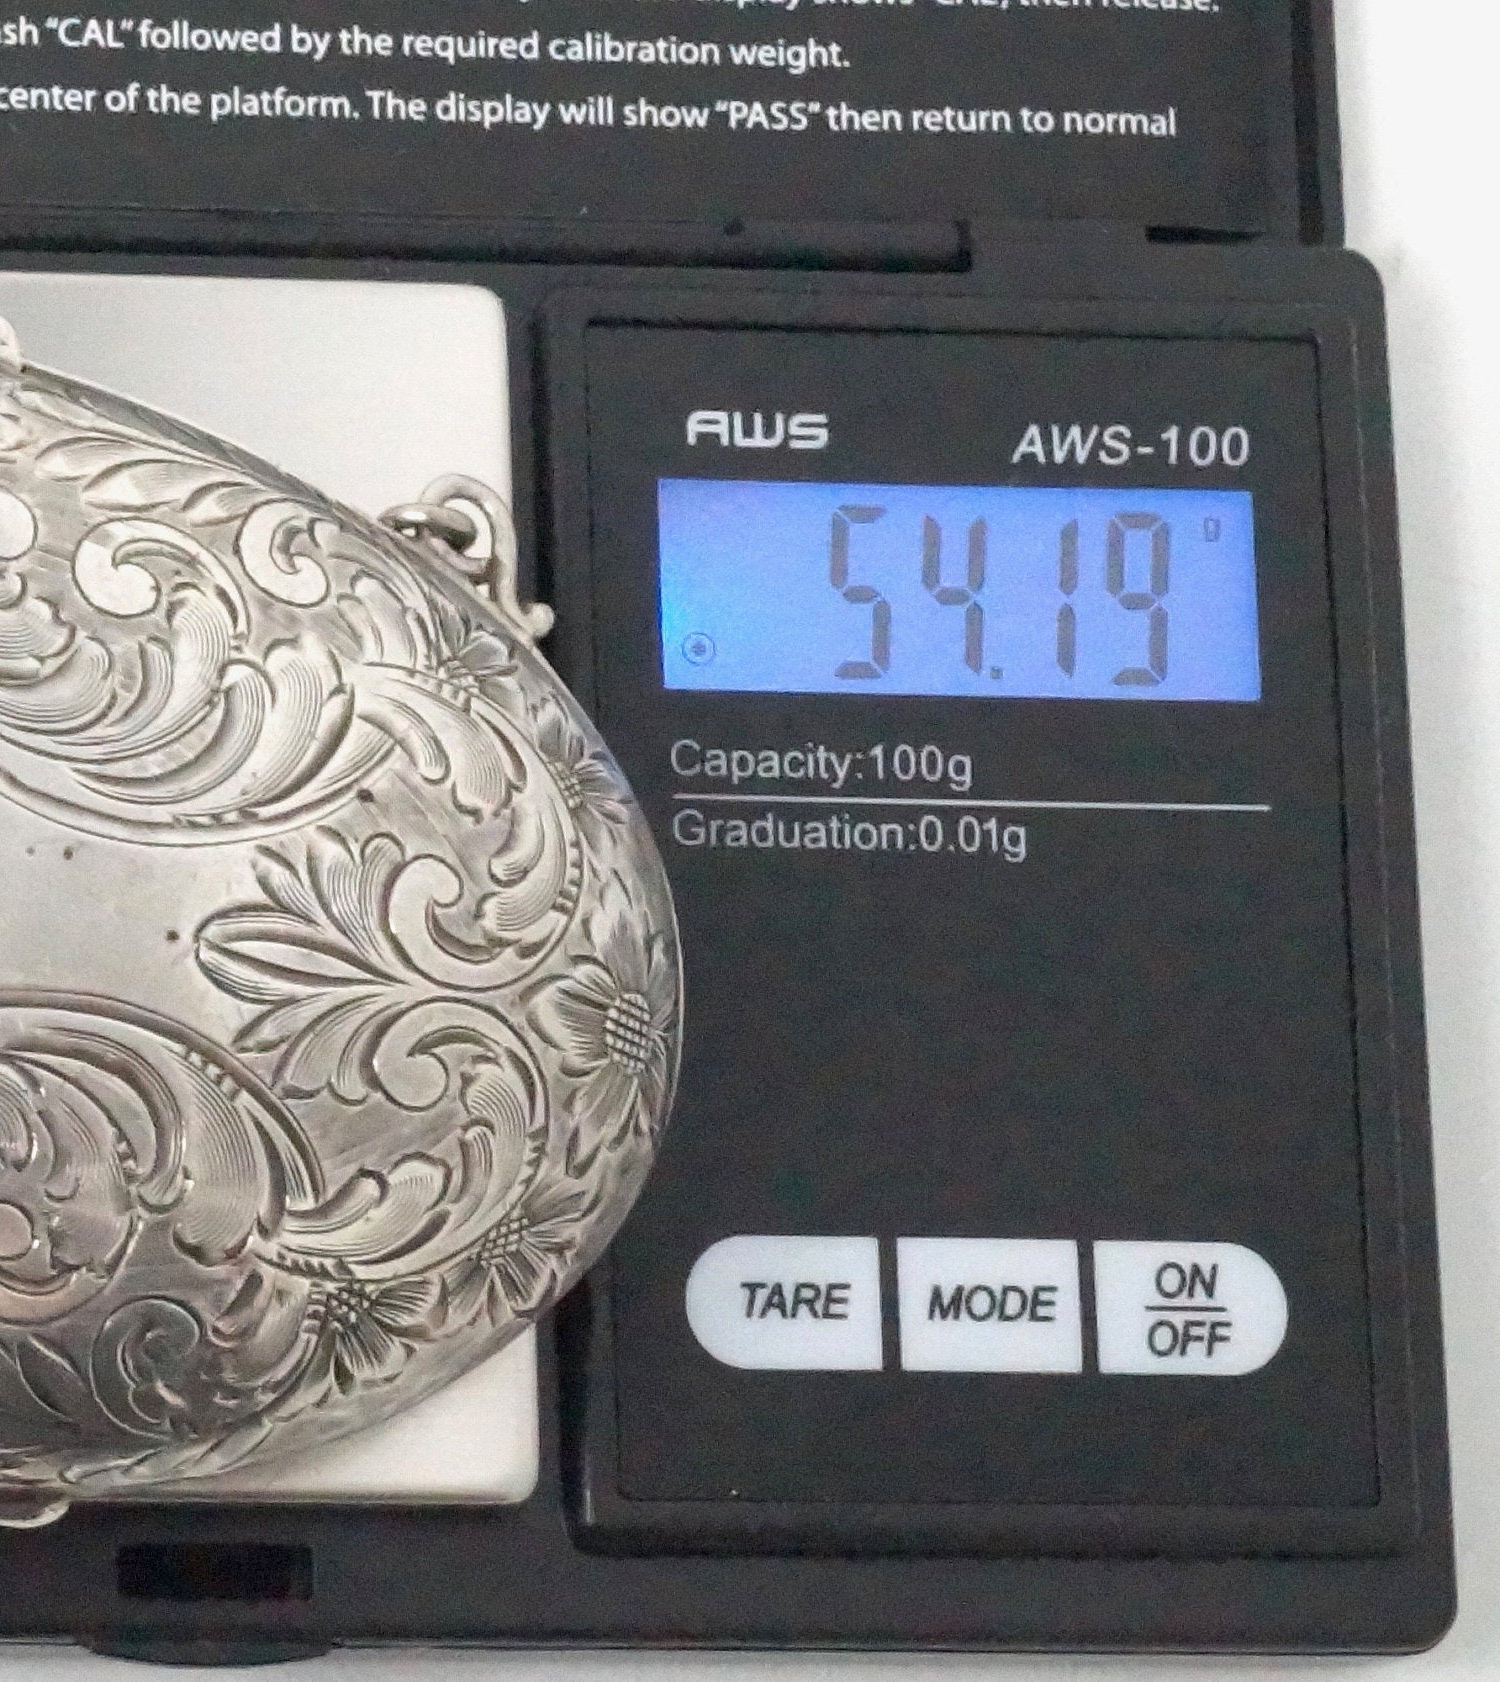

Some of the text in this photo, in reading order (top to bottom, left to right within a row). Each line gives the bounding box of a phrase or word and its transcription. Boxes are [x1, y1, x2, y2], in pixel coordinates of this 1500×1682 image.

[137, 18, 282, 53] followed
[290, 23, 332, 61] by
[338, 25, 394, 57] the
[402, 30, 540, 66] required
[547, 32, 721, 65] calibration
[728, 38, 851, 74] weight.
[104, 81, 140, 113] of
[146, 84, 202, 115] the
[211, 86, 360, 123] platform.
[365, 90, 428, 122] The
[434, 91, 552, 130] display
[557, 96, 614, 127] will
[623, 97, 710, 129] show
[825, 102, 903, 132] then
[911, 105, 1012, 132] return
[1019, 107, 1055, 133] to
[1063, 107, 1176, 137] normal
[685, 409, 830, 450] AWS
[1010, 423, 1250, 467] AWS-100
[829, 504, 1172, 687] 54.19
[669, 738, 974, 792] Capacity:100g
[672, 809, 1028, 863] Graduation:0.01g
[739, 1281, 852, 1320] TARE
[1153, 1261, 1220, 1300] ON
[927, 1284, 1058, 1323] MODE
[1146, 1319, 1233, 1358] OFF
